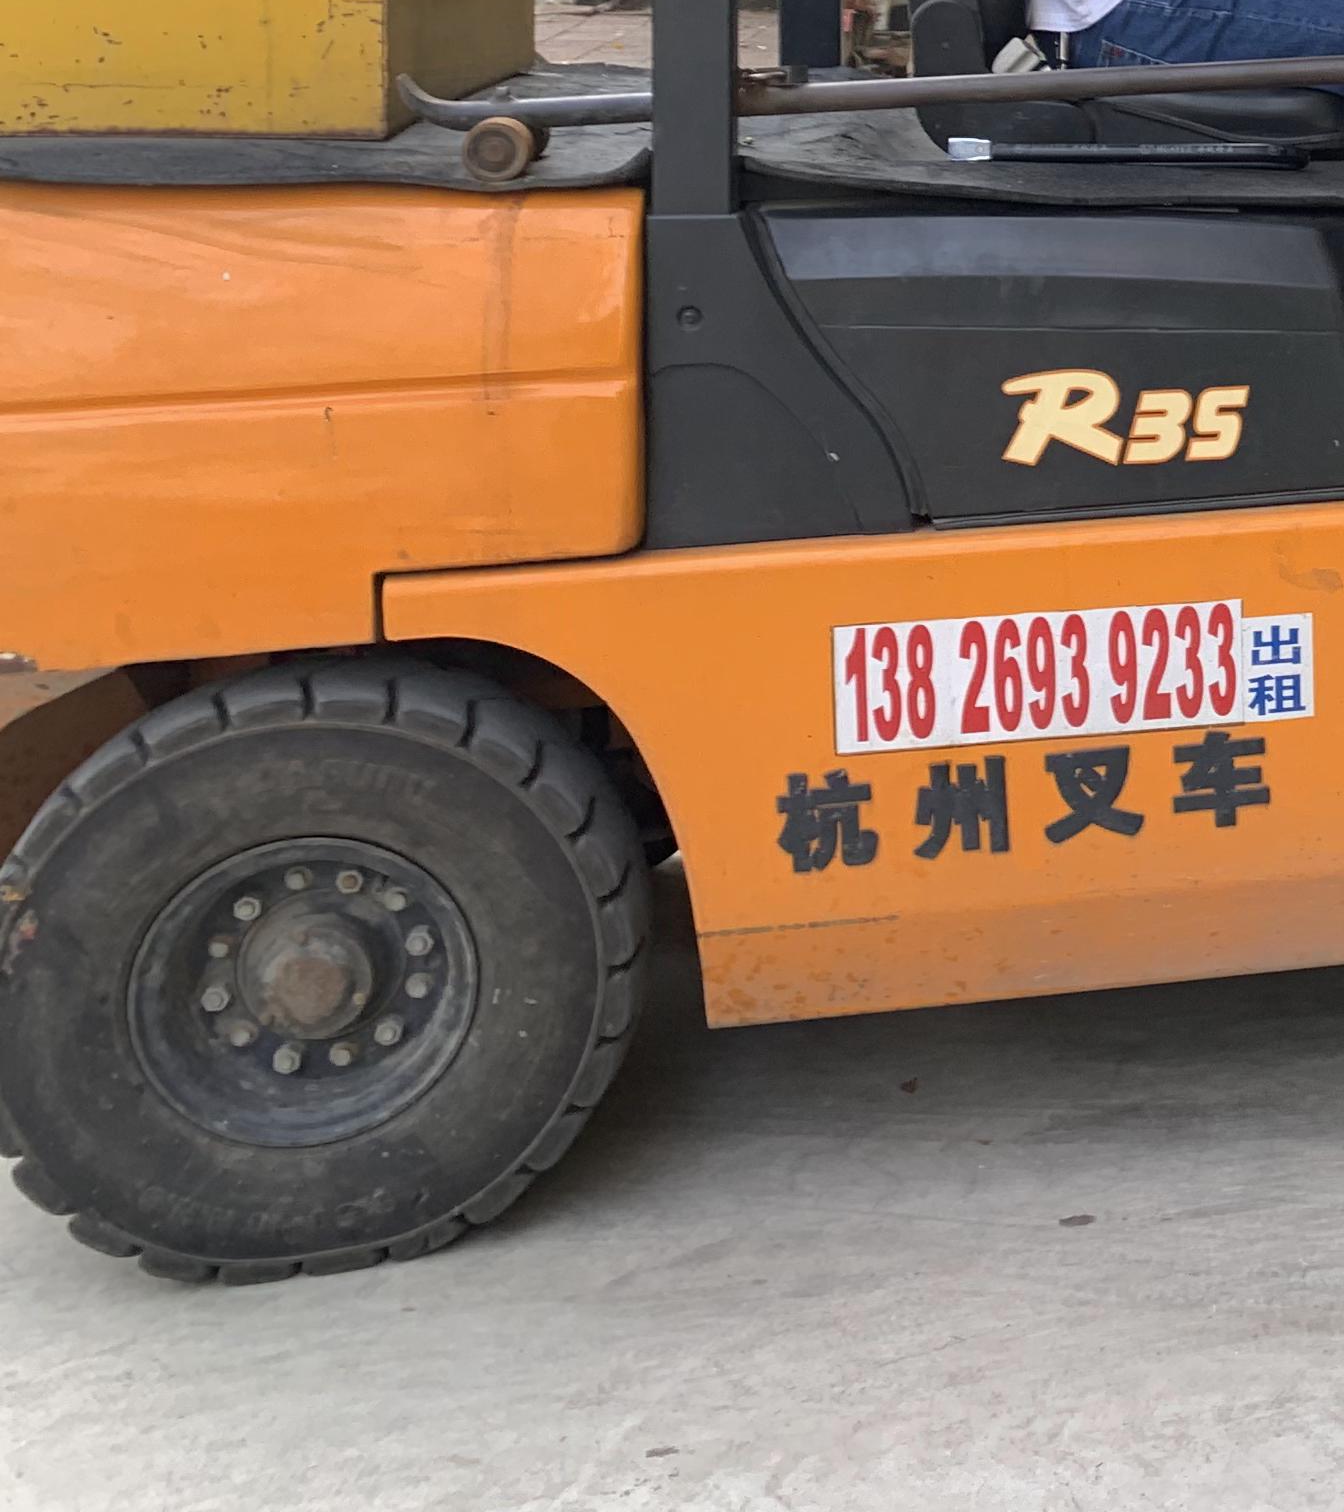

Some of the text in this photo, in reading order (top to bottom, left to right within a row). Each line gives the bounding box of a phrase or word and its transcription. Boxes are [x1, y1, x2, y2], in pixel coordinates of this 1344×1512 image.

[1001, 368, 1250, 466] R35
[845, 603, 1237, 742] 138 2693 9233
[1248, 625, 1306, 716] 出租
[776, 731, 1271, 873] 杭州叉车
